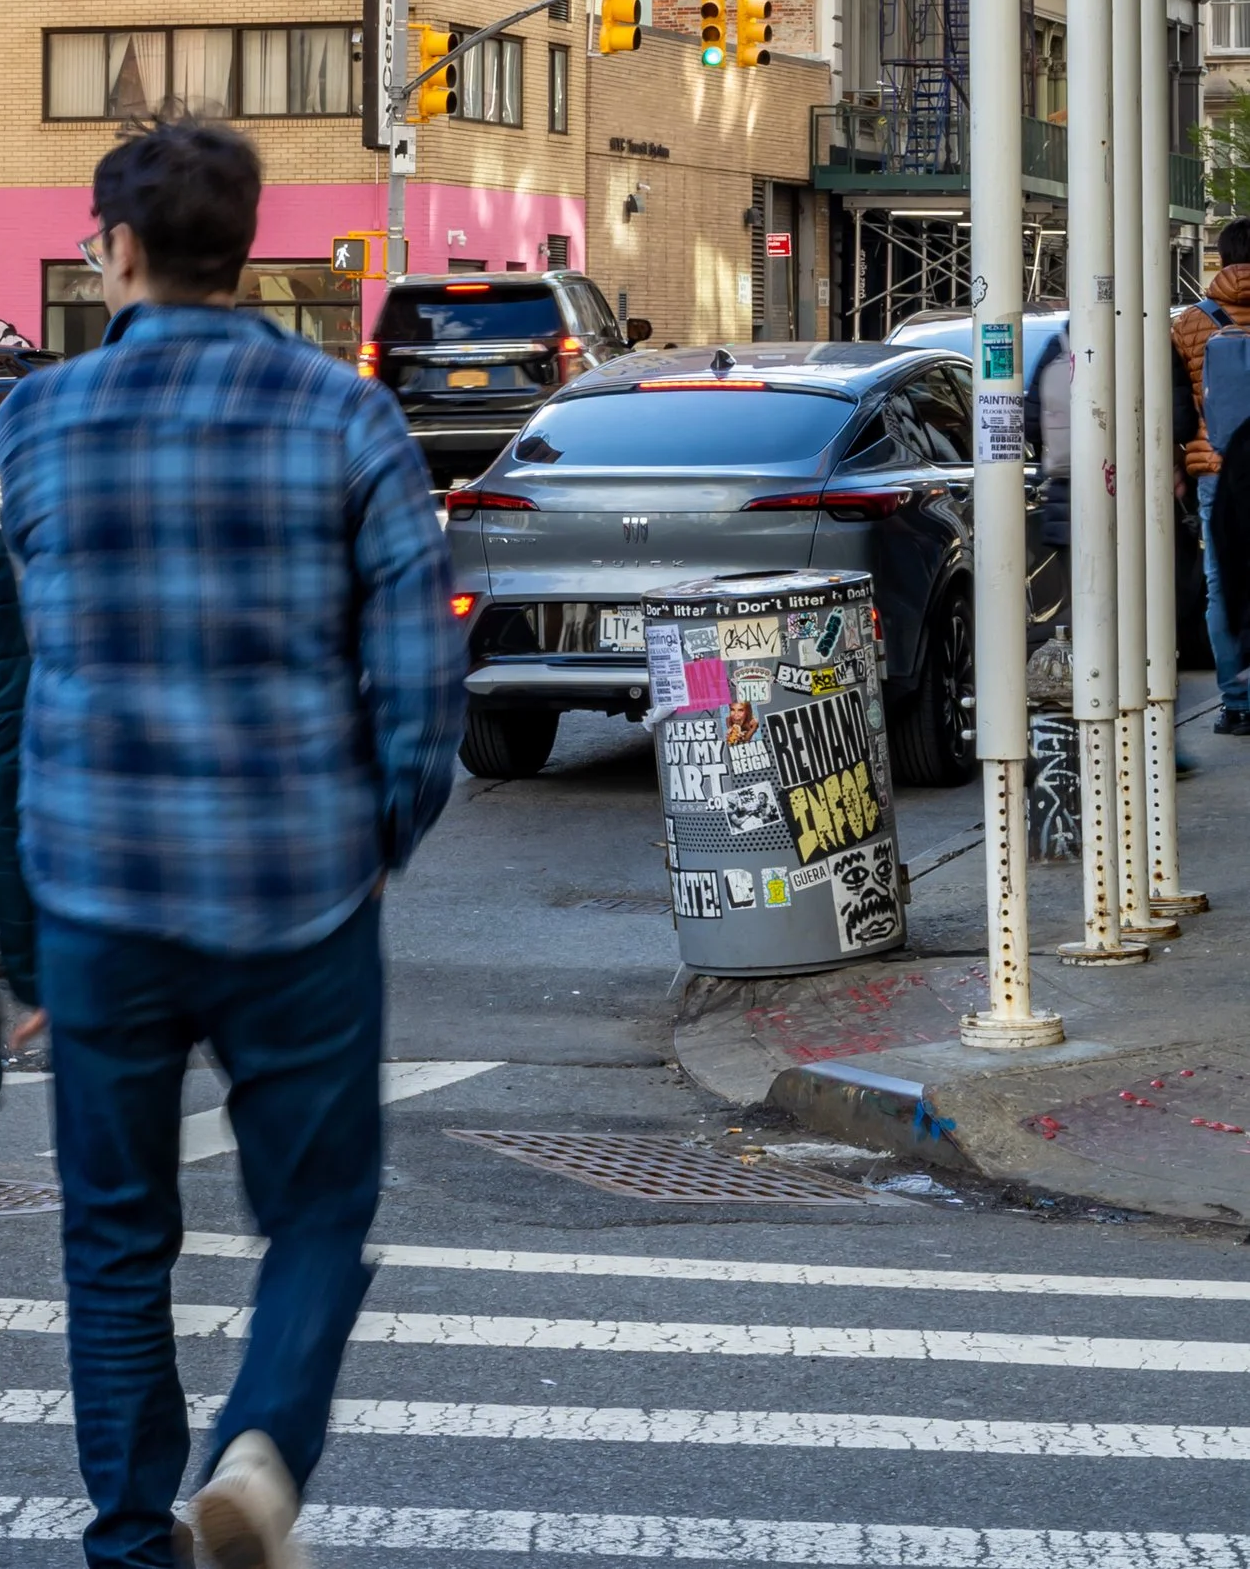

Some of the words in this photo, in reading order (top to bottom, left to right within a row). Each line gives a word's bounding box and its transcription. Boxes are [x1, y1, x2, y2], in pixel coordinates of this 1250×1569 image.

[978, 395, 1021, 405] PAINTING
[673, 604, 707, 617] litter
[789, 595, 826, 608] litter
[665, 720, 717, 741] PLEASE
[664, 741, 690, 764] BUY
[693, 740, 725, 764] MY
[728, 739, 768, 761] NEMA
[731, 754, 772, 776] REIGN
[669, 764, 730, 801] ART
